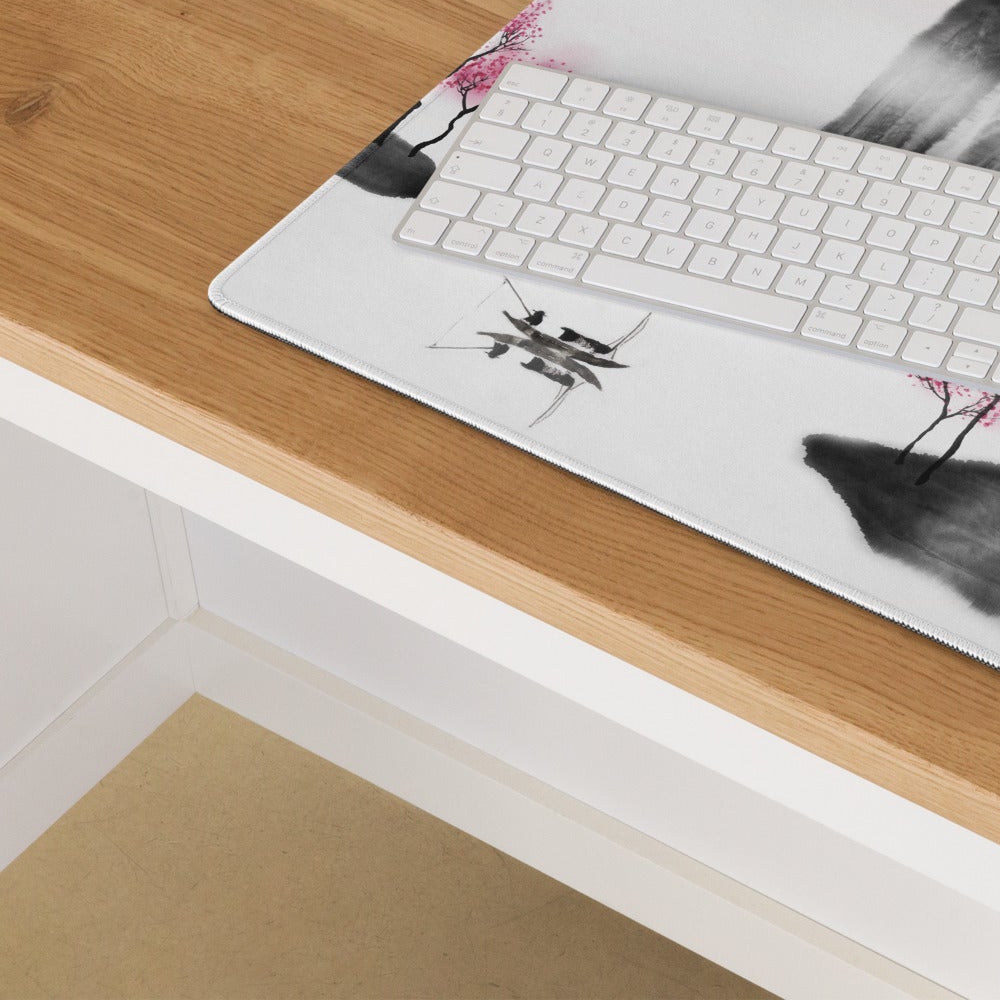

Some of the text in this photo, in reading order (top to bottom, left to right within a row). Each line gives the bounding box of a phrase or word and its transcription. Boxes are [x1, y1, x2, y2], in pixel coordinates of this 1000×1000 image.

[542, 148, 553, 157] Q
[584, 157, 597, 167] W
[627, 168, 637, 177] E
[669, 178, 680, 187] R
[715, 188, 723, 196] T
[758, 198, 766, 206] Y
[799, 208, 810, 217] U
[886, 229, 897, 238] O
[929, 239, 940, 247] P
[580, 128, 590, 137] 2
[621, 138, 632, 147] 3
[707, 158, 716, 166] 5
[750, 168, 759, 176] 6
[793, 178, 803, 186] 7
[835, 188, 845, 197] 8
[879, 198, 889, 207] 9
[922, 208, 933, 217] 0
[535, 215, 807, 286] Z X C V B N M
[618, 200, 629, 209] D
[662, 210, 671, 218] F
[704, 221, 715, 230] G
[747, 231, 760, 240] H
[791, 242, 801, 250] J
[835, 251, 845, 261] K
